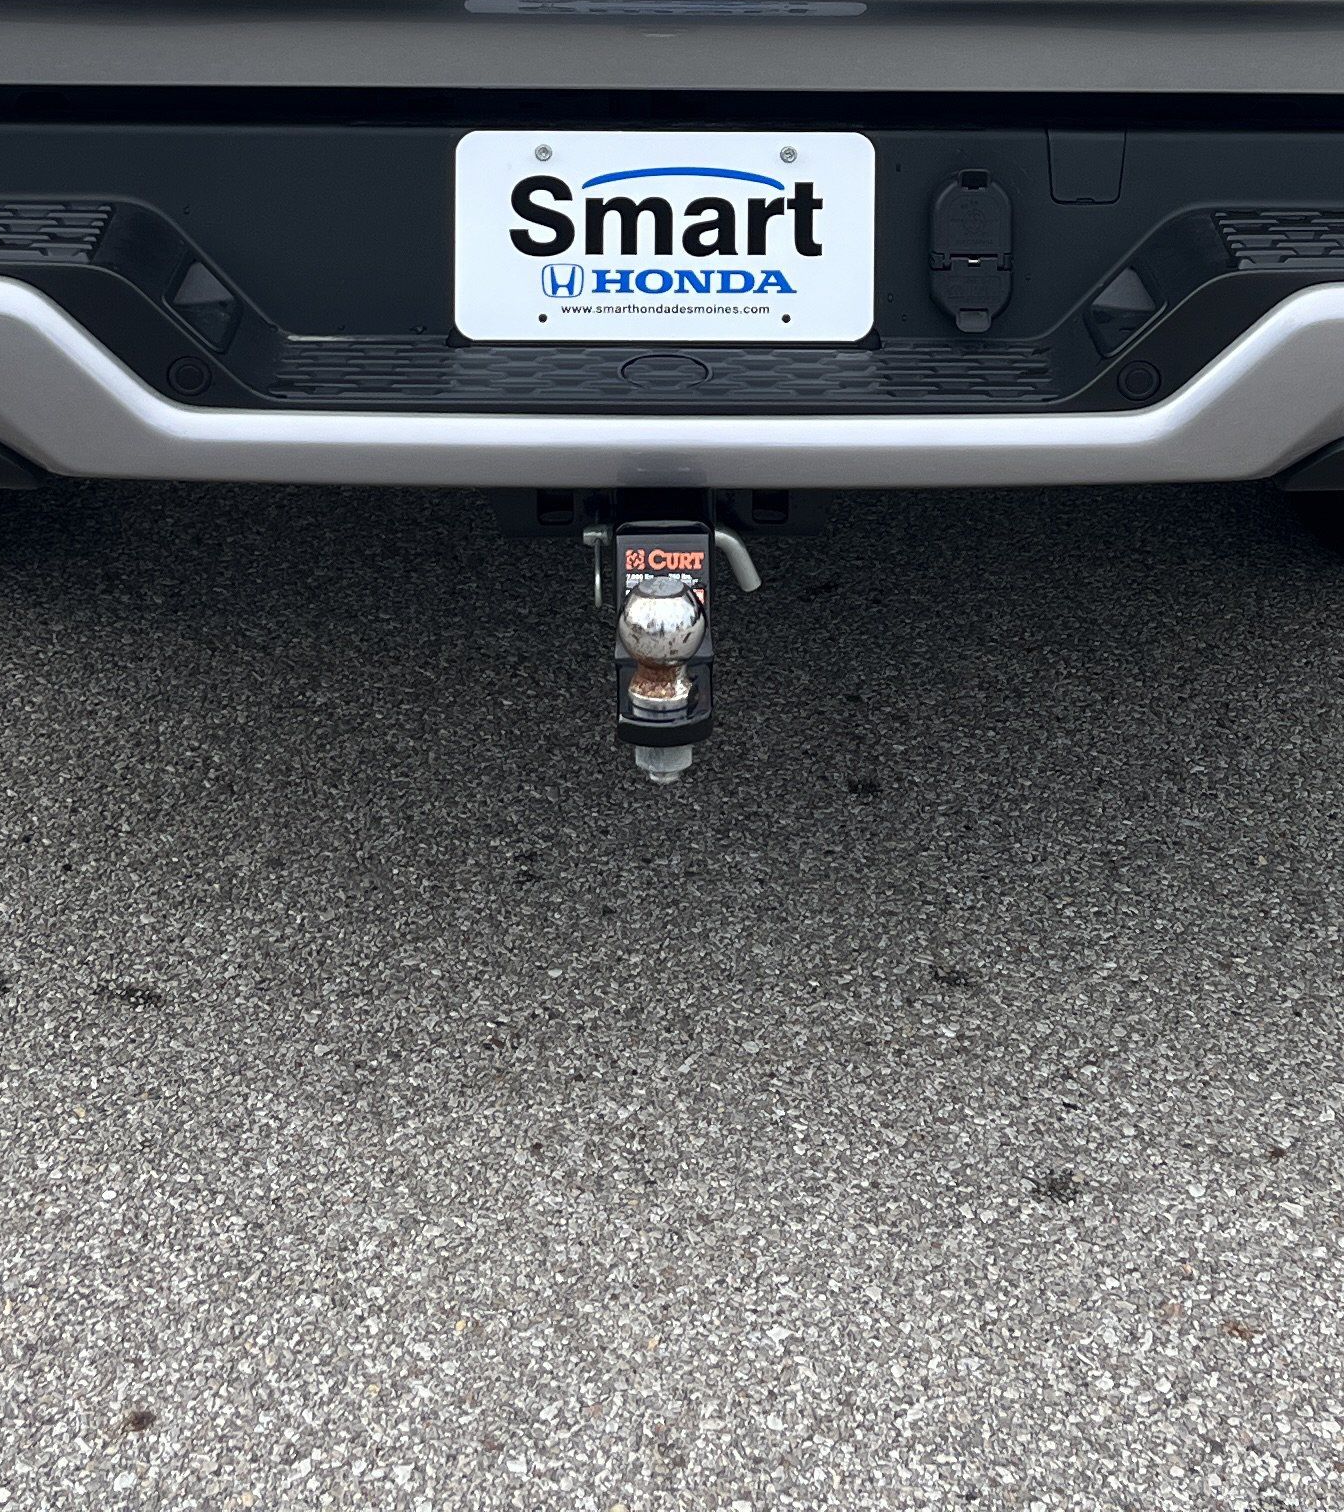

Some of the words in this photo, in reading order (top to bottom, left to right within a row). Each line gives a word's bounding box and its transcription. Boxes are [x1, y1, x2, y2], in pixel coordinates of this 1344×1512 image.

[509, 175, 823, 257] Smart
[592, 269, 797, 294] HONDA
[561, 303, 770, 315] www.smarthondadesmoines.com
[648, 548, 705, 570] CURT
